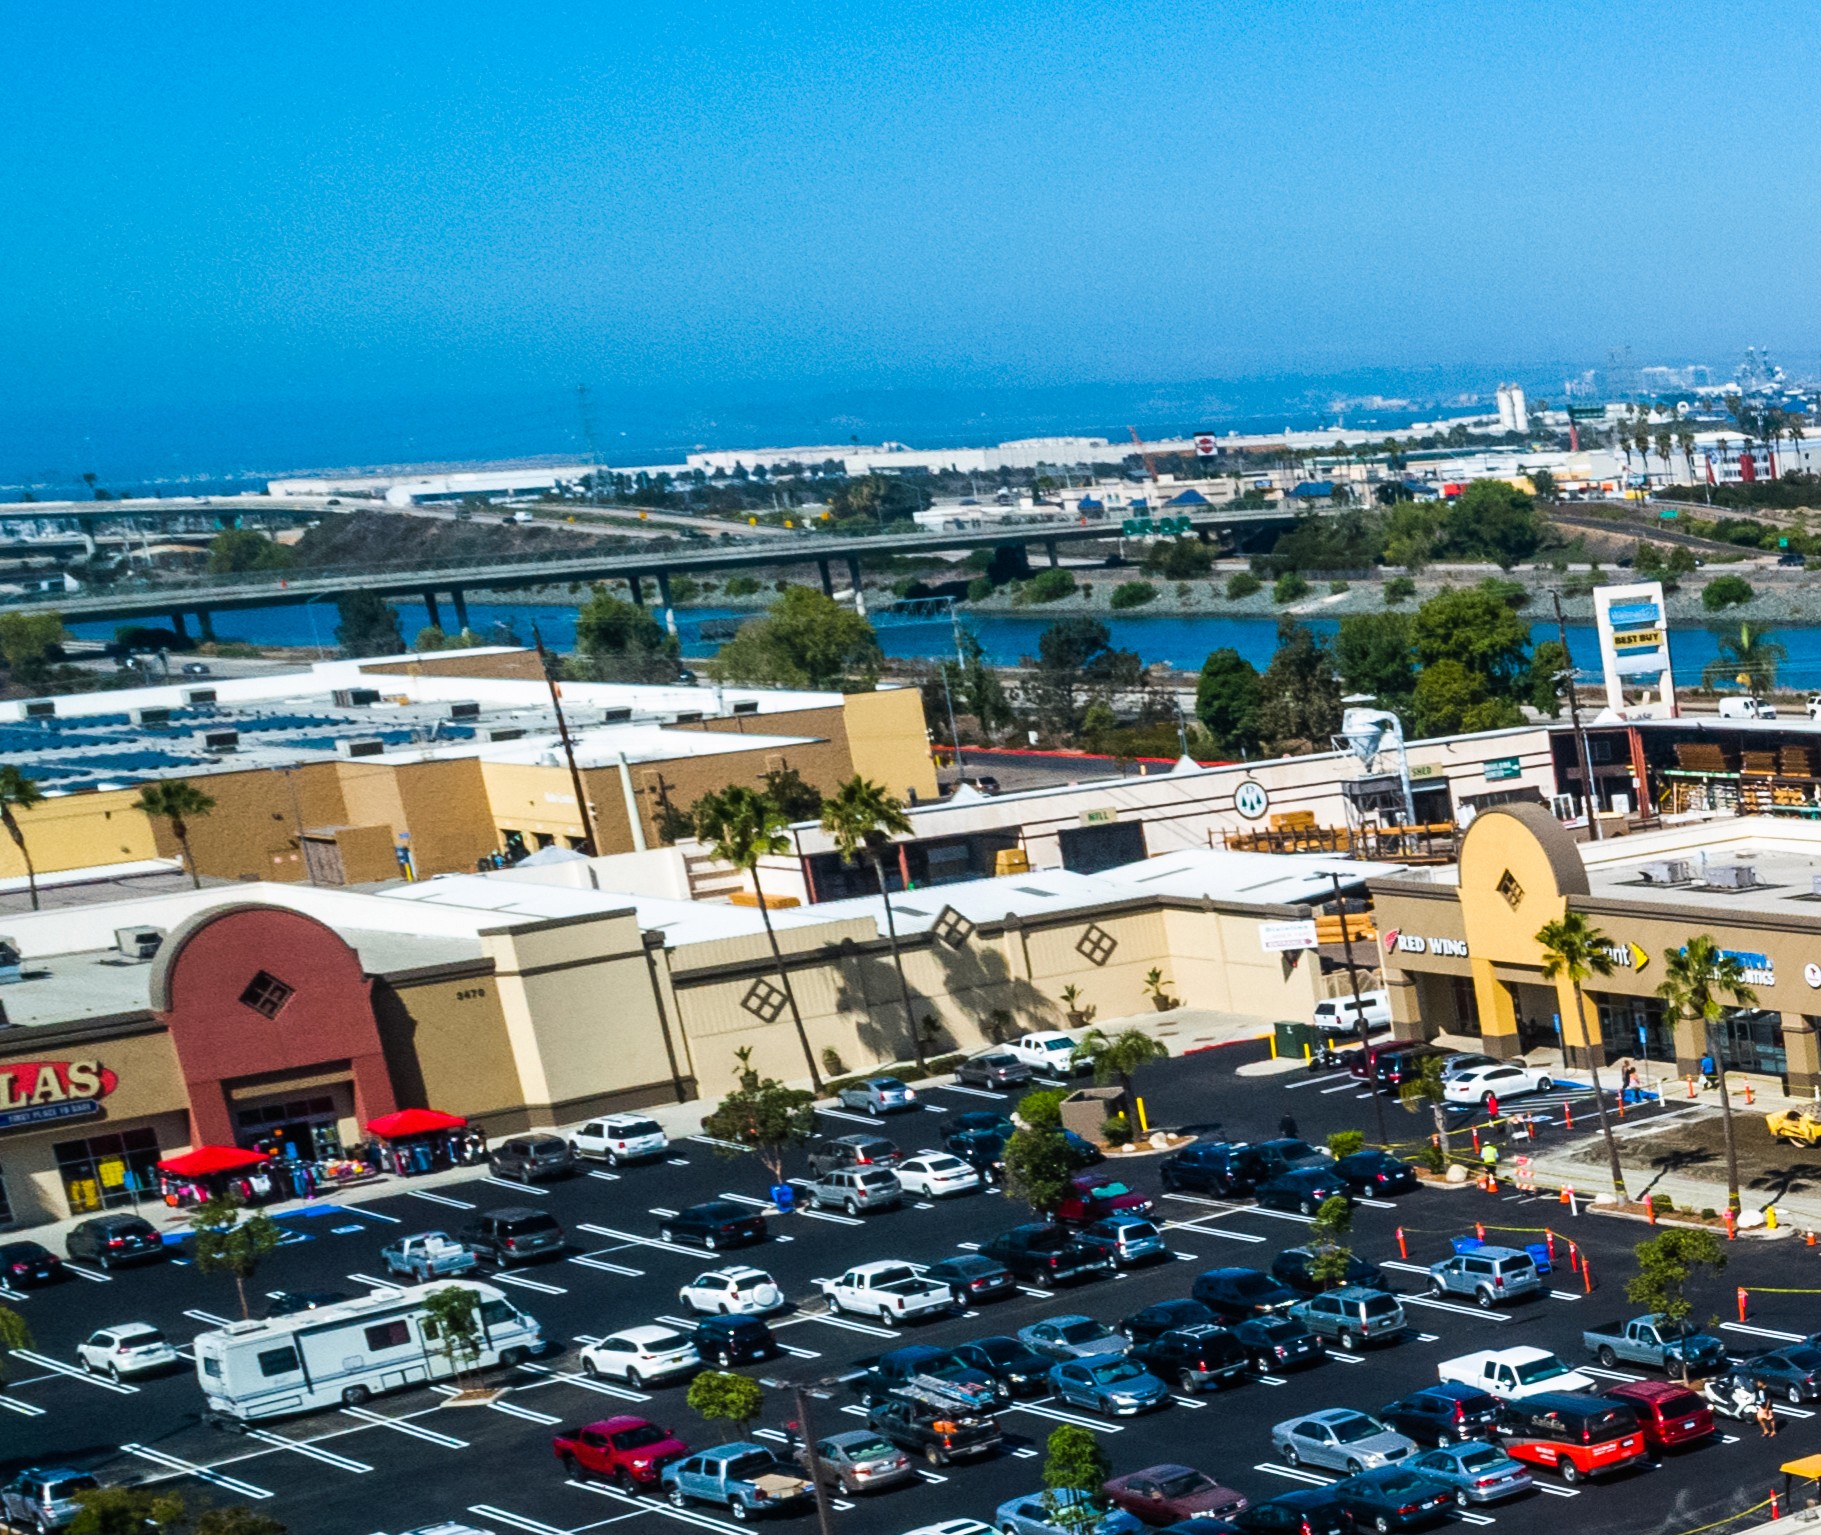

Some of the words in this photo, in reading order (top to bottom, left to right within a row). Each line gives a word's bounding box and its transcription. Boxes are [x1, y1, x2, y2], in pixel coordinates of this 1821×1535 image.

[1614, 634, 1638, 645] BEST
[1639, 632, 1659, 643] BUY
[1397, 934, 1427, 953] RED
[1428, 937, 1469, 958] WING
